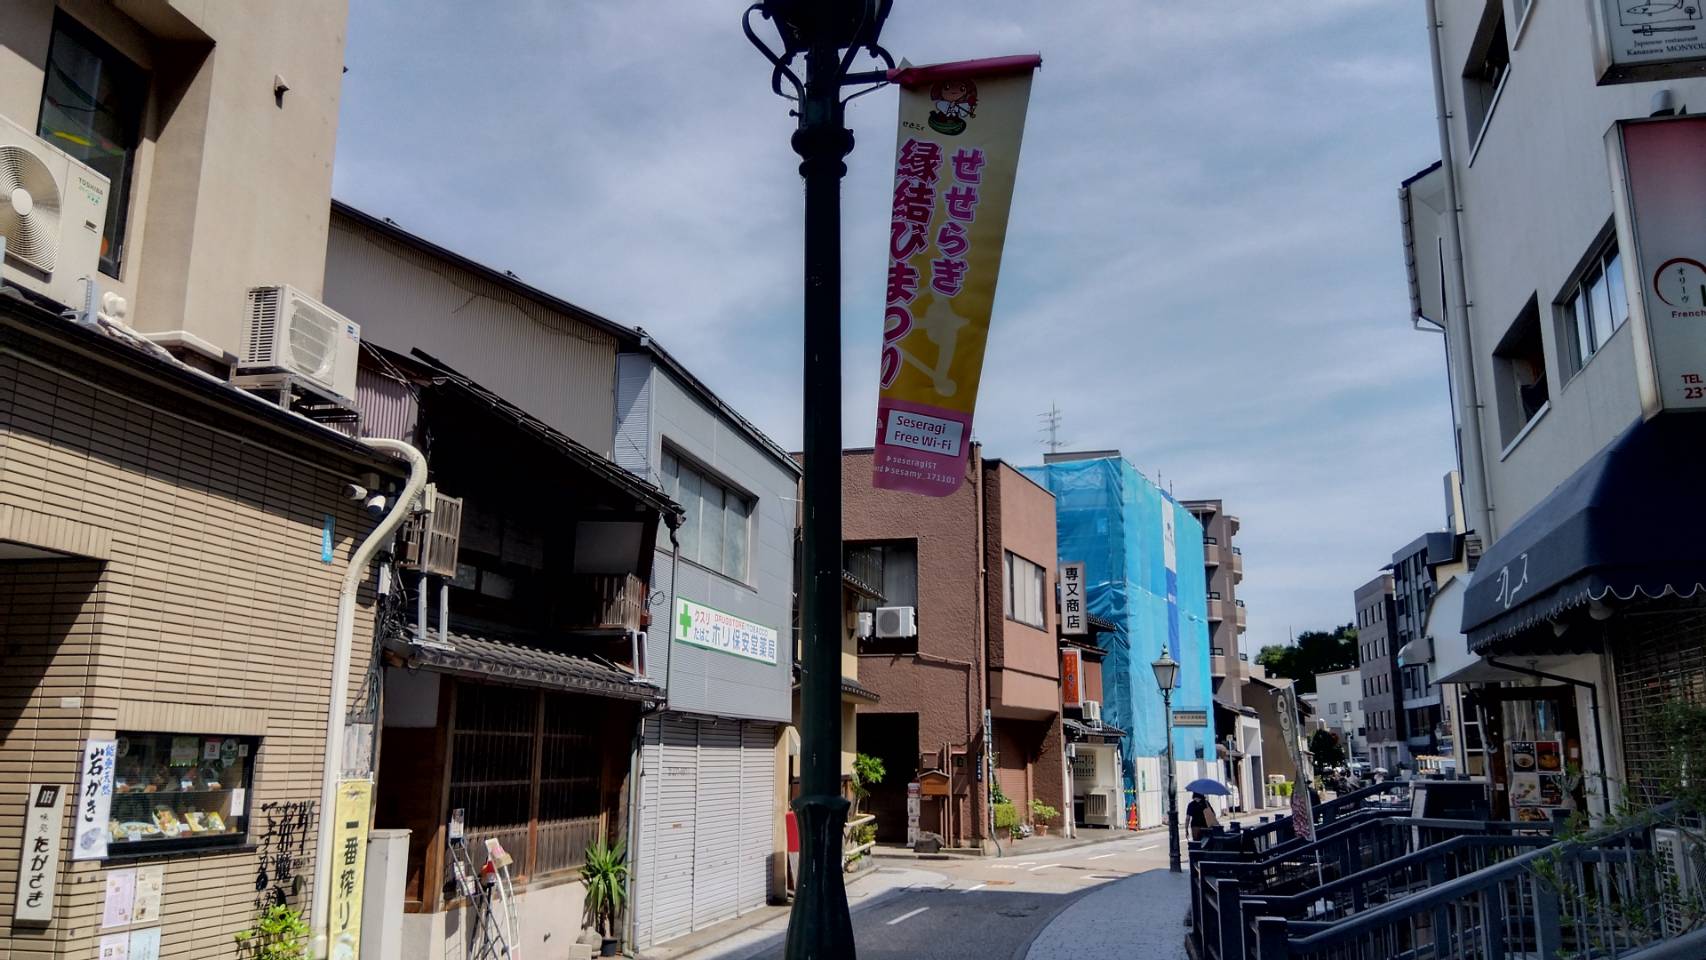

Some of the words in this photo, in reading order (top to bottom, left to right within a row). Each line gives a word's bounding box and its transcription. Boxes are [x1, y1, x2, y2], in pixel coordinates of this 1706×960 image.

[931, 148, 985, 296] せせらぎ
[881, 139, 943, 388] 縁結びまつり
[1671, 309, 1706, 319] French
[1681, 373, 1704, 385] TEL
[1684, 386, 1706, 400] 23
[896, 415, 946, 435] Seseragi
[894, 430, 919, 445] Free
[922, 435, 952, 450] Wi-Fi
[1066, 567, 1080, 629] 専又商店
[694, 609, 711, 625] クスリ
[694, 627, 710, 642] たばこ
[85, 747, 105, 822] 岩がき
[339, 821, 360, 931] 一番搾り
